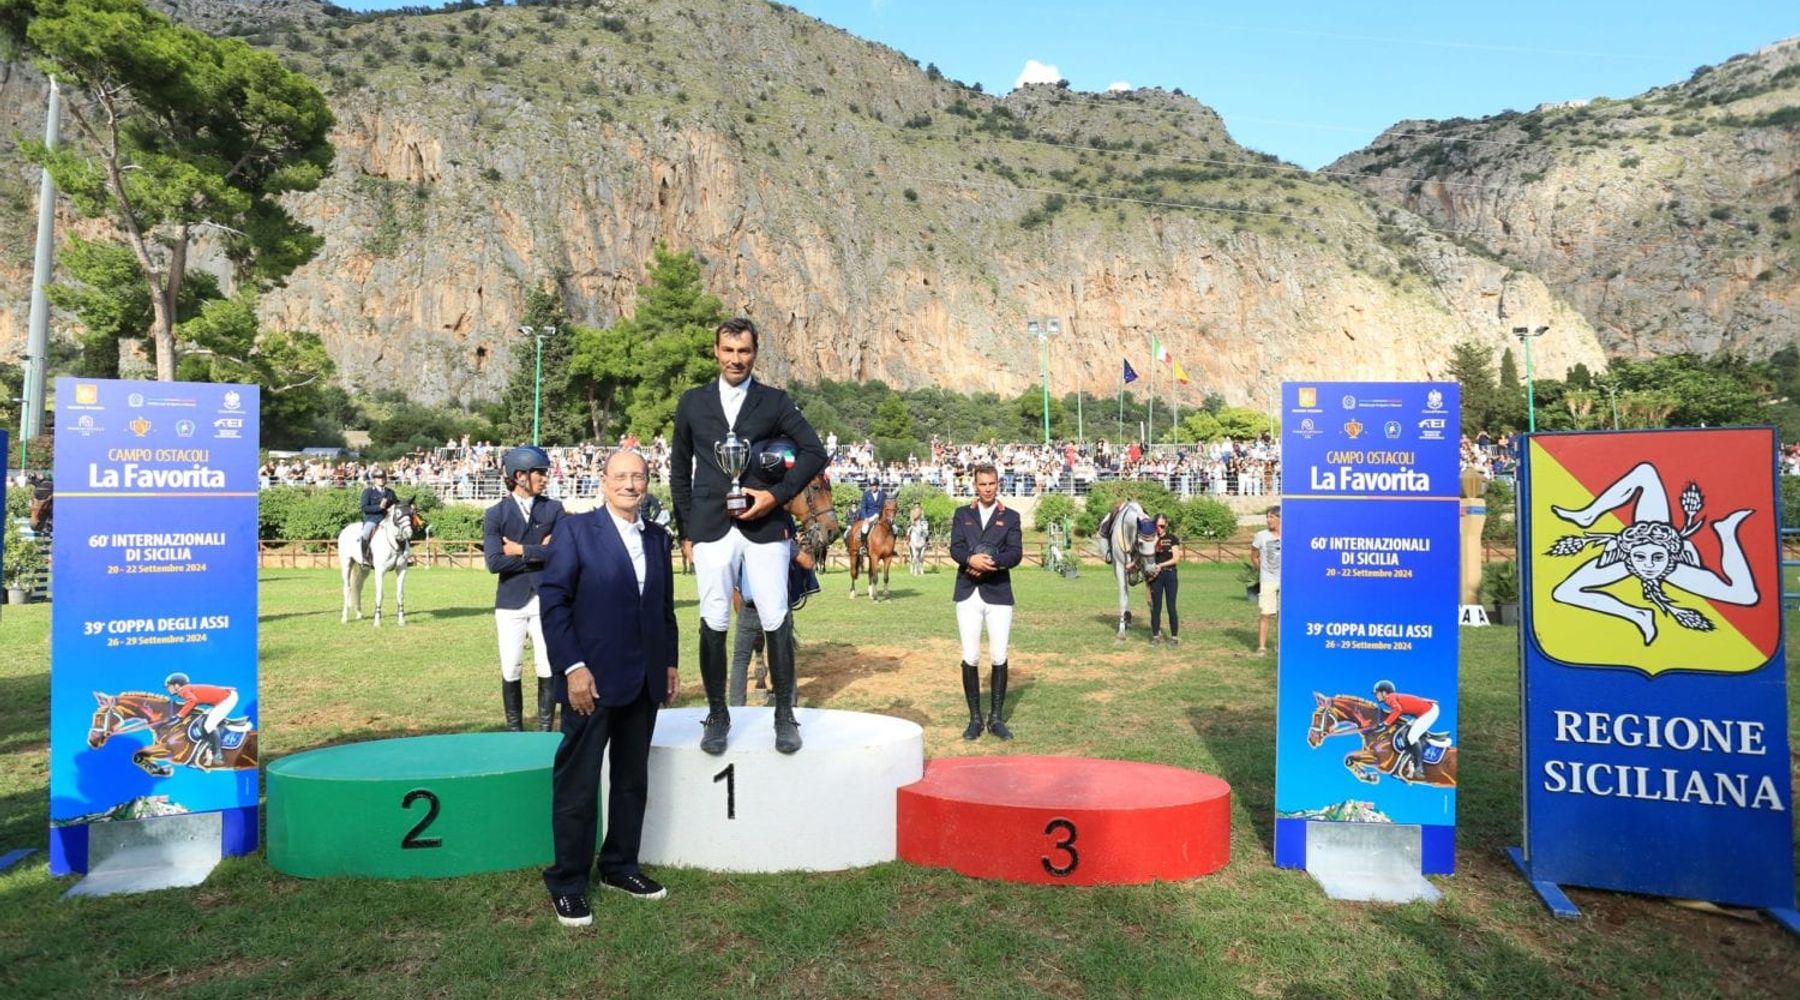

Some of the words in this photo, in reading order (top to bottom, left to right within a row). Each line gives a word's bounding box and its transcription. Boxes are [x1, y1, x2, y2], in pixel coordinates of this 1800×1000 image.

[108, 448, 151, 462] CAMPO
[156, 448, 209, 462] OSTACOLI
[1326, 451, 1364, 464] CAMPO
[1367, 452, 1414, 465] OSTACOLI
[89, 463, 119, 488] La
[124, 464, 225, 488] Favorita
[1311, 466, 1335, 490] La
[1341, 466, 1430, 491] Favorita
[112, 533, 225, 547] INTERNAZIONALI
[1330, 537, 1430, 551] INTERNAZIONALI
[125, 548, 140, 561] DI
[144, 548, 192, 561] SICILIA
[1342, 552, 1354, 565] DI
[1357, 553, 1399, 566] SICILIA
[107, 566, 119, 574] 20
[126, 565, 136, 574] 22
[138, 565, 184, 573] Settembre
[186, 564, 207, 572] 2024
[1326, 568, 1336, 576] 20
[1352, 569, 1392, 577] Settembre
[1394, 570, 1413, 578] 2024
[1462, 609, 1471, 623] A
[108, 619, 155, 633] COPPA
[158, 617, 197, 631] DEGLI
[200, 615, 229, 629] ASSI
[1326, 623, 1366, 637] COPPA
[1368, 624, 1403, 637] DEGLI
[1406, 625, 1432, 638] ASSI
[138, 636, 184, 645] Settembre
[186, 634, 207, 642] 2024
[1325, 640, 1336, 649] 26
[1342, 641, 1351, 649] 29
[1352, 641, 1392, 650] Settembre
[1393, 641, 1412, 650] 2024
[1554, 710, 1767, 755] REGIONE
[713, 763, 735, 820] 1
[1544, 760, 1785, 811] SICILIANA
[402, 789, 442, 849] 2
[1042, 819, 1079, 877] 3
